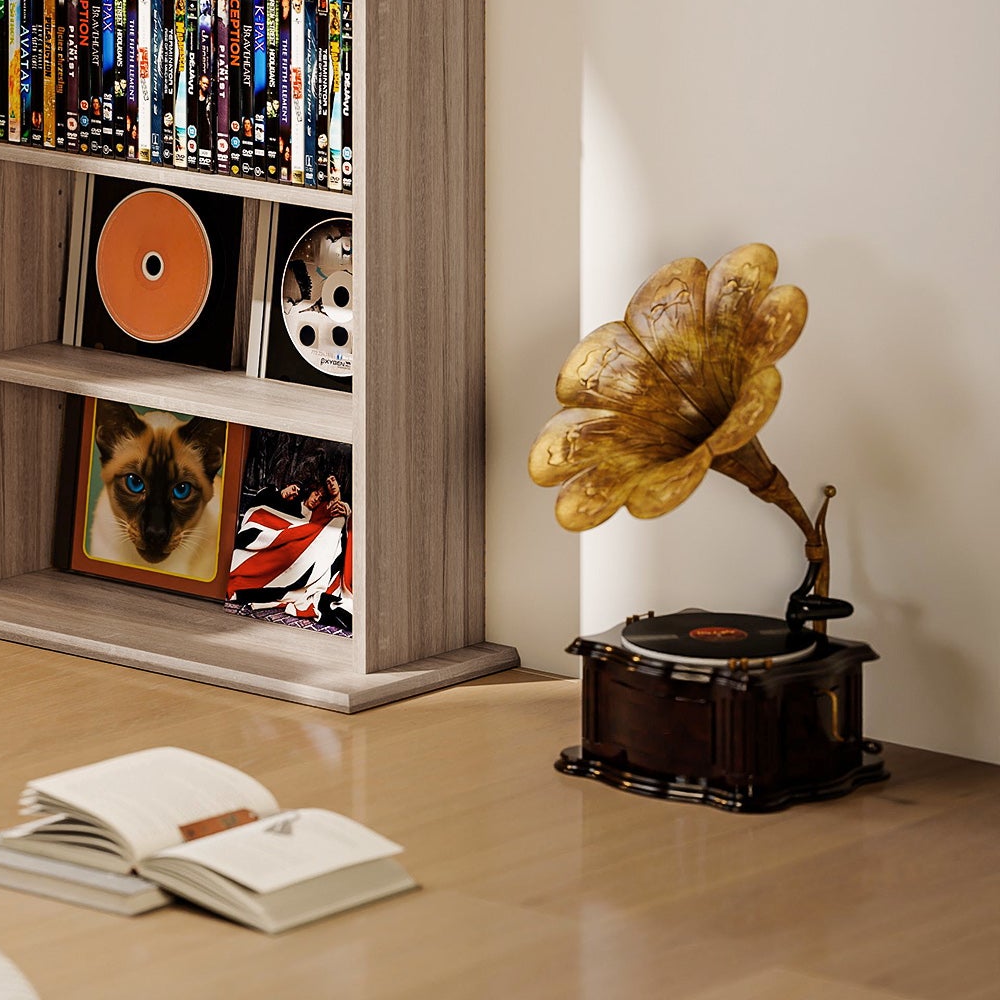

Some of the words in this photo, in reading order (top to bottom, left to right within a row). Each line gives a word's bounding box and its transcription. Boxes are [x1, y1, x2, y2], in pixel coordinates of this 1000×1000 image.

[20, 25, 30, 93] AVATAR
[92, 5, 101, 66] BRAVEHEART
[243, 25, 252, 87] BRAVEHEART
[255, 5, 265, 52] K-PAX
